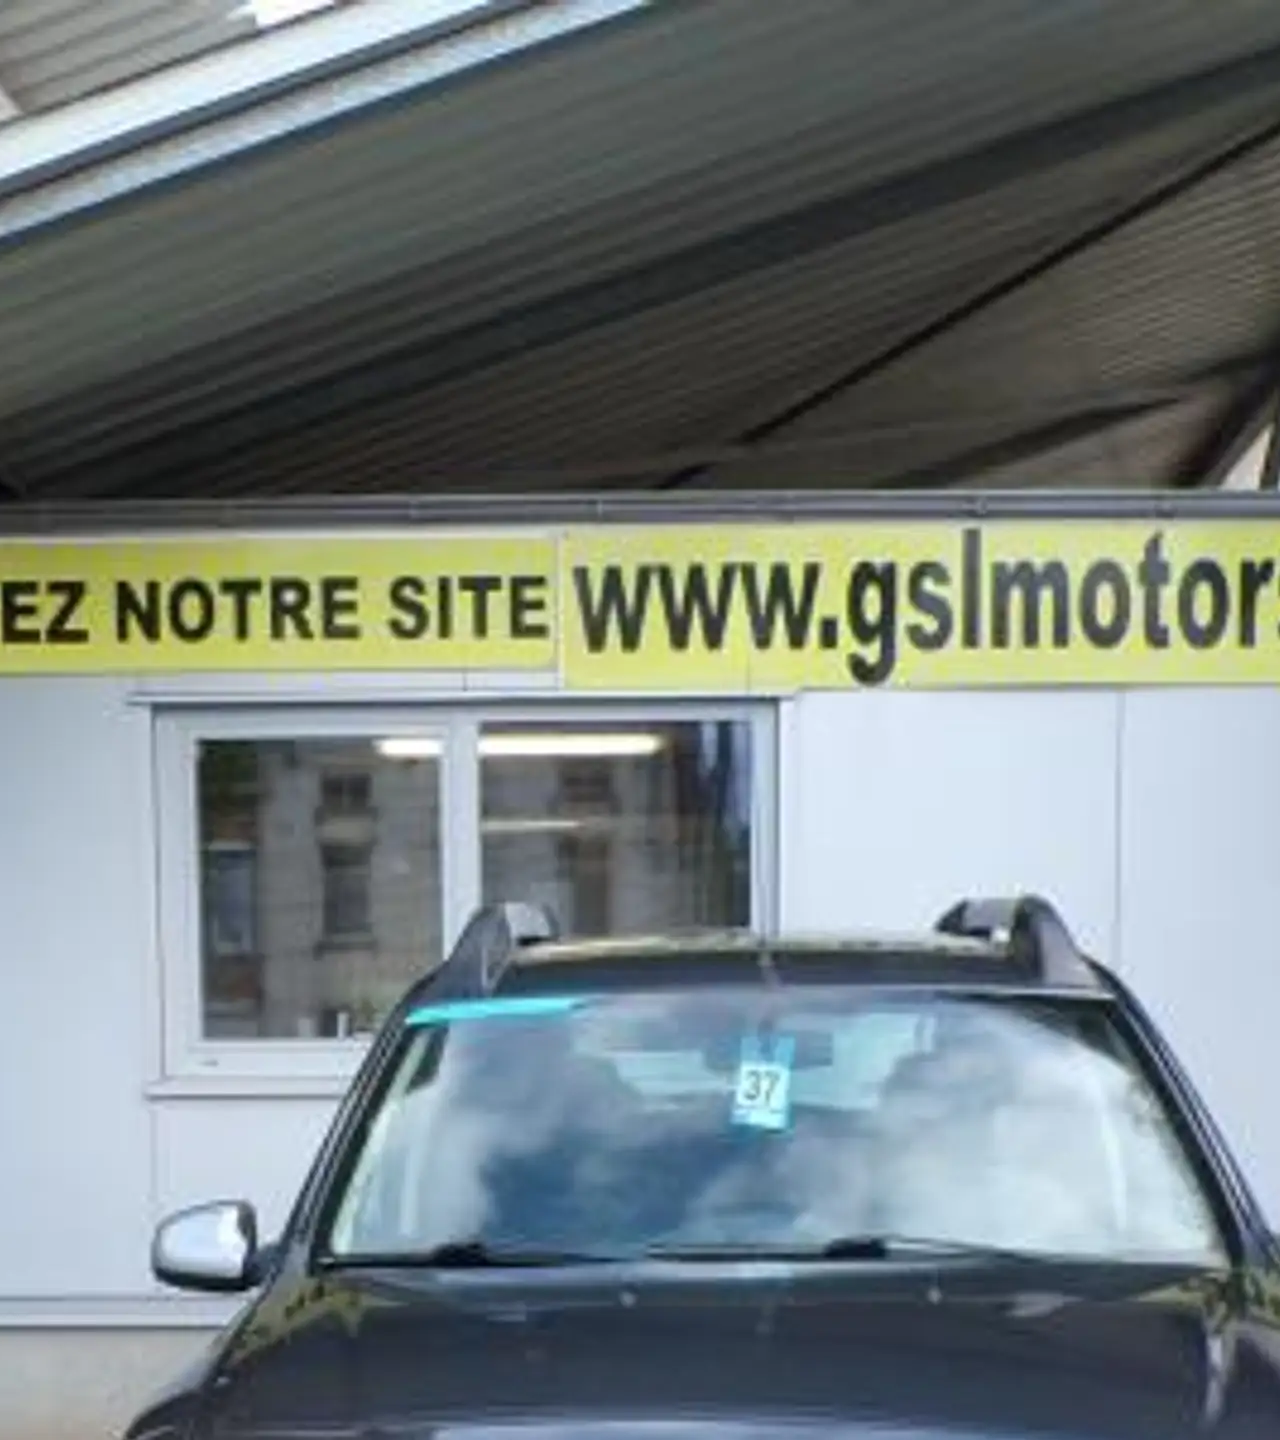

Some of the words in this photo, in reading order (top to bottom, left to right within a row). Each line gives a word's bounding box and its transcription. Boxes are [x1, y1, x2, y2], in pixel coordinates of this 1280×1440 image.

[116, 575, 361, 644] NOTRE
[388, 575, 549, 640] SITE
[743, 1068, 781, 1104] 37
